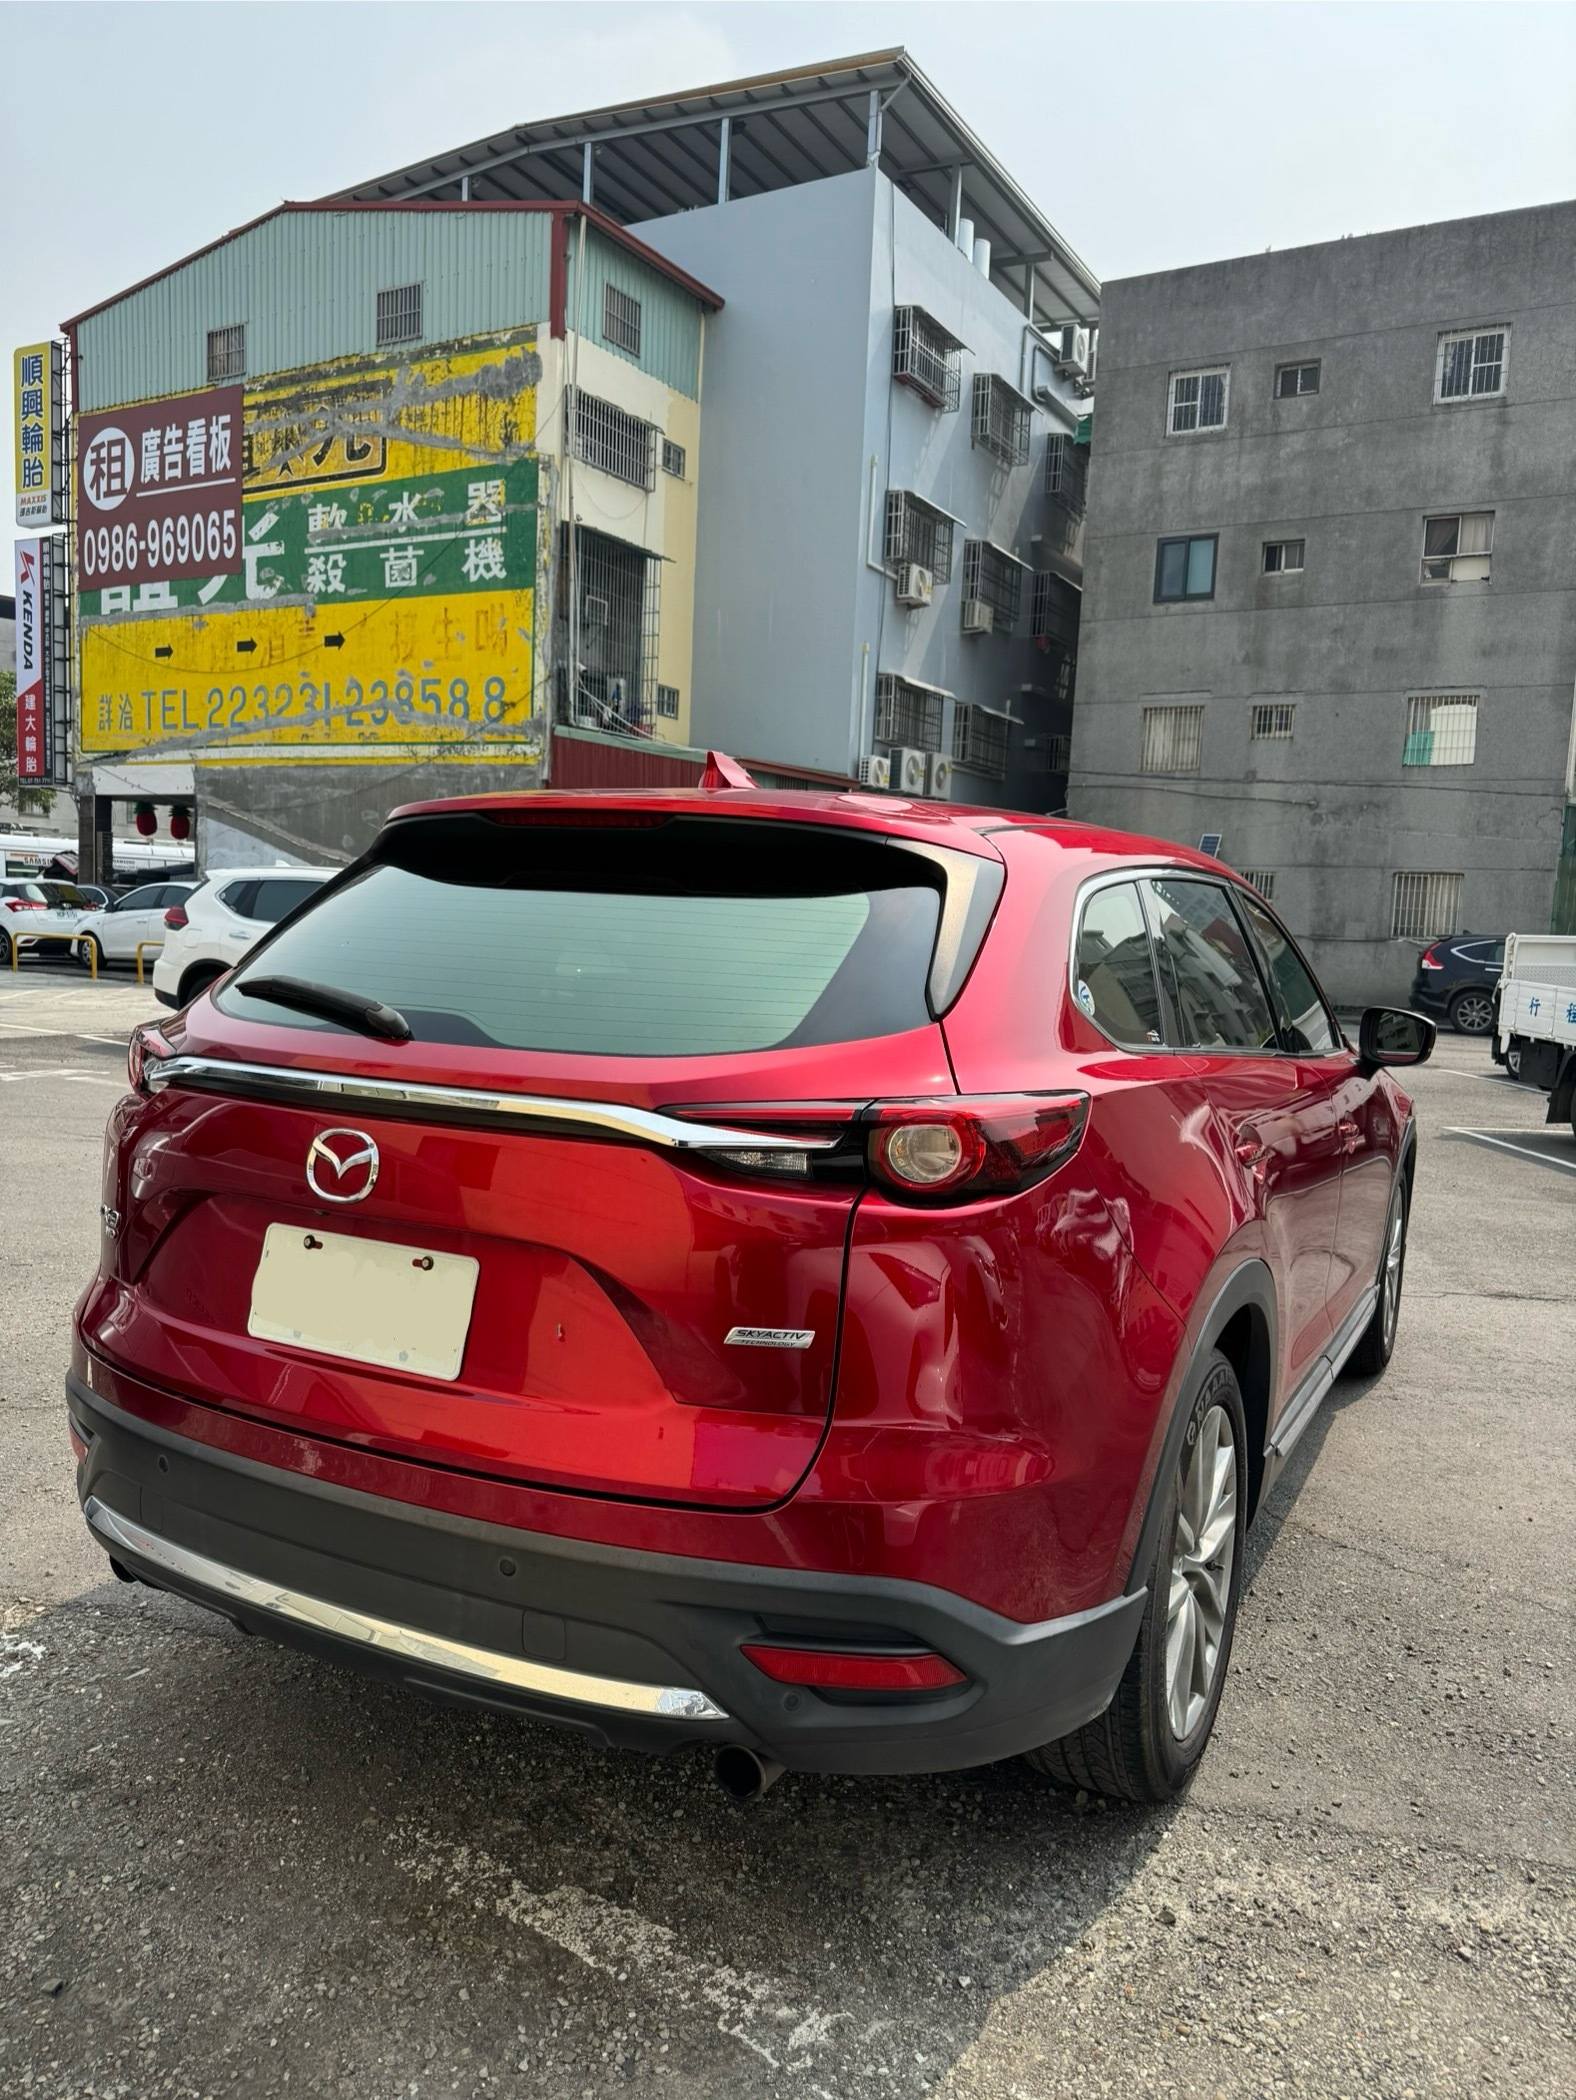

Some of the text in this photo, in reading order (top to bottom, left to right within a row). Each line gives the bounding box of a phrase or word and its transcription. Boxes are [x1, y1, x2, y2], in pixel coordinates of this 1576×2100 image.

[21, 354, 44, 489] 順興輪胎
[90, 437, 129, 502] 租
[140, 413, 232, 485] 廣告看板
[20, 494, 48, 506] MAXXIS
[84, 508, 236, 576] 0986-969065
[306, 538, 507, 595] 殺菌機
[23, 590, 37, 670] KENDA
[25, 694, 38, 774] 建大輪胎
[98, 693, 133, 731] 詳洽
[141, 688, 200, 730] TEL
[736, 1329, 808, 1340] SKYACTIV
[740, 1339, 797, 1347] TECHNOLOGY
